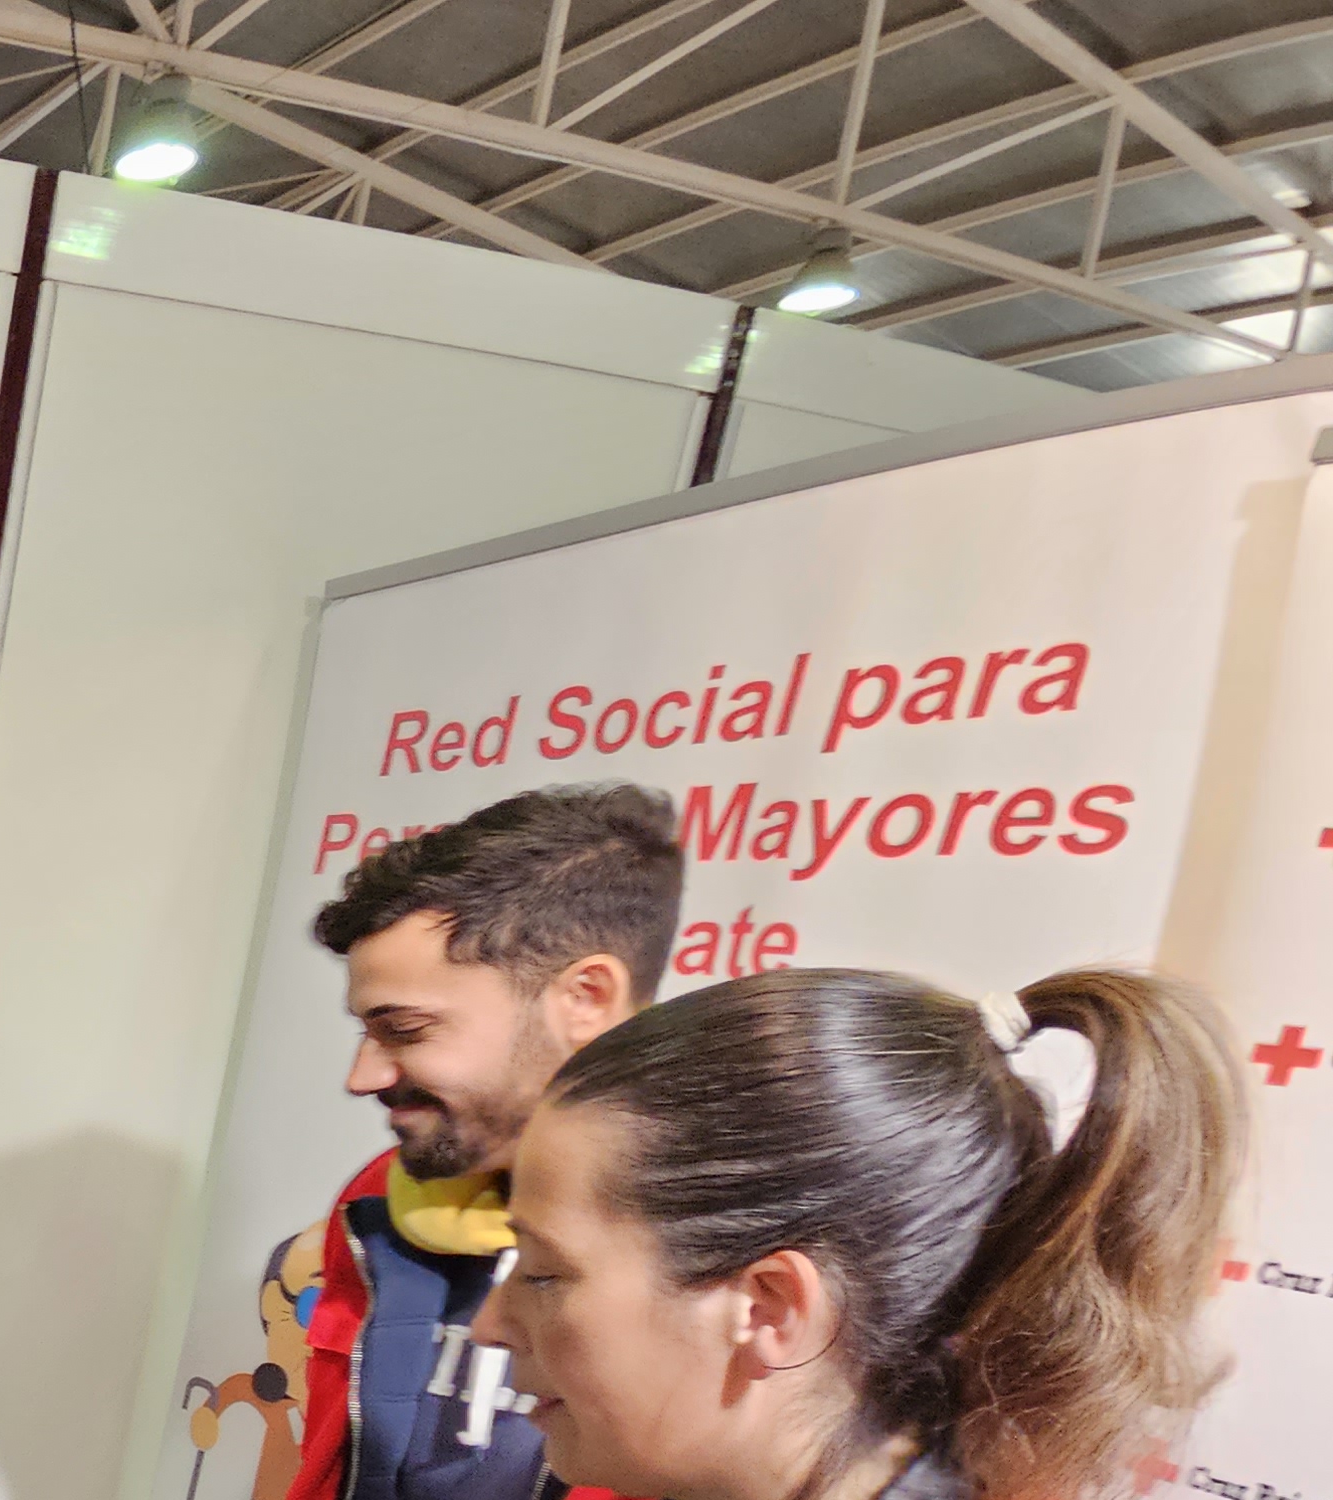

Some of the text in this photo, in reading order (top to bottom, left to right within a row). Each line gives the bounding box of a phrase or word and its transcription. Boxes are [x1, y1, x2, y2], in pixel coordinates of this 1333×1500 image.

[381, 639, 1091, 778] Red Social para
[680, 779, 1136, 882] Mayores
[1257, 1261, 1322, 1295] Cruz
